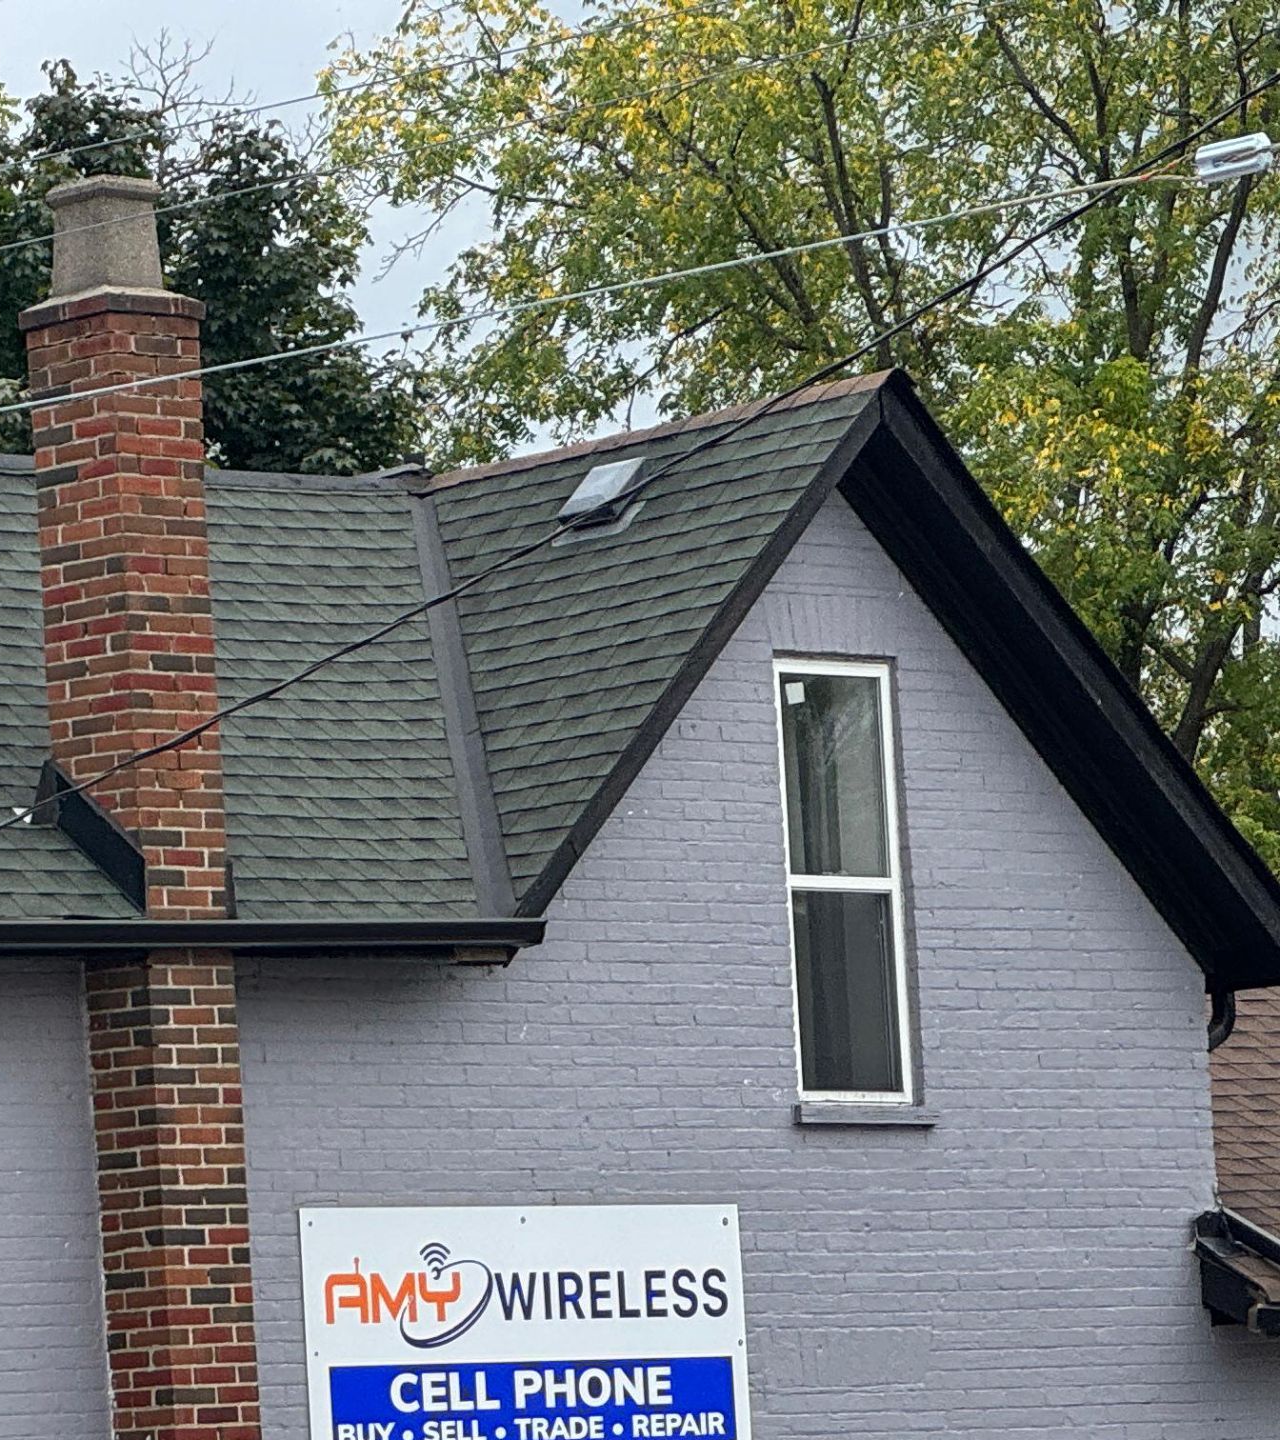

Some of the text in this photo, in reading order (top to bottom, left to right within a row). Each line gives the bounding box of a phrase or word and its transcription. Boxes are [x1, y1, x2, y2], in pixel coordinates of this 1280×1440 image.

[325, 1268, 728, 1324] AMY WIRELESS
[390, 1366, 673, 1413] CELL PHONE
[515, 1416, 605, 1440] TRADE
[632, 1412, 725, 1438] REPAIR
